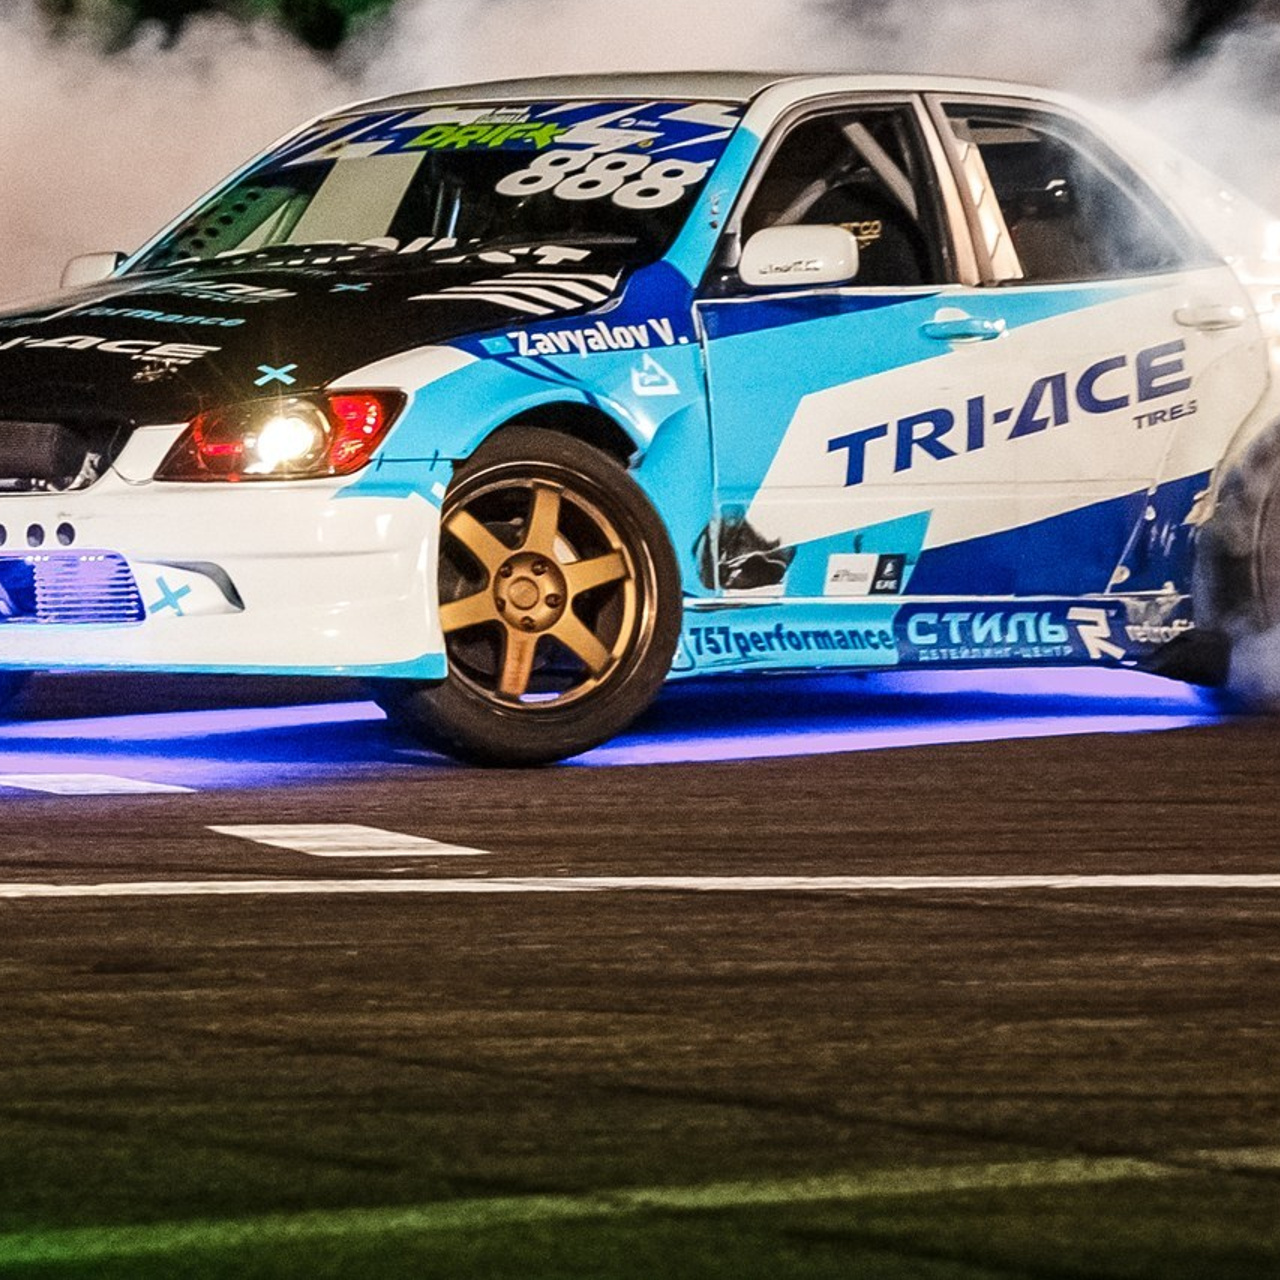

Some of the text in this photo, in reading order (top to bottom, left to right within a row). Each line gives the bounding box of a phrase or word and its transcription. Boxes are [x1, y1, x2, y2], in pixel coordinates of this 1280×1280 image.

[495, 150, 717, 209] 888
[506, 318, 689, 359] Zavyalov V.
[827, 339, 1194, 488] TRI-ACE
[1132, 399, 1199, 430] TIRES
[689, 622, 896, 658] 757performance
[907, 610, 1069, 646] СТИЛЬ
